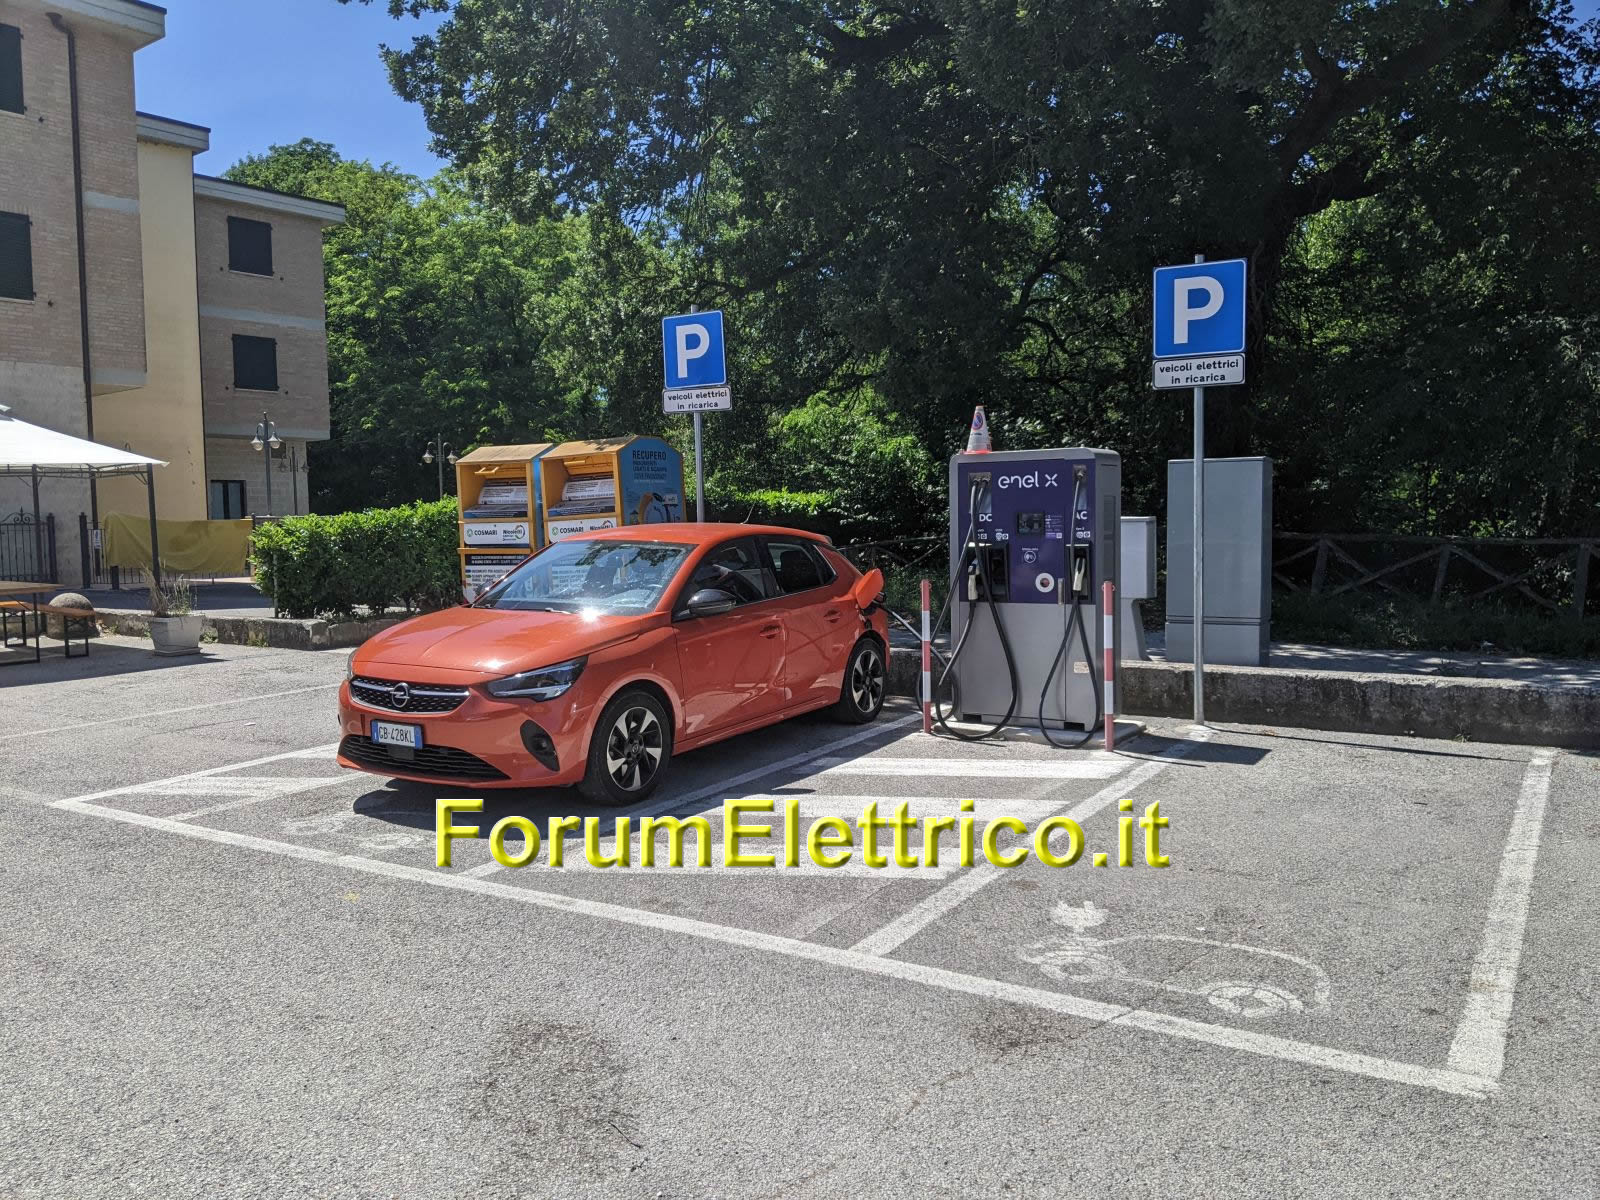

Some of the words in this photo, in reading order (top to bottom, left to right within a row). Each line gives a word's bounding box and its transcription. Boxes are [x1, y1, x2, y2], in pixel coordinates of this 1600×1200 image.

[1173, 275, 1225, 345] P
[675, 323, 710, 379] P
[1159, 362, 1192, 374] veicoli
[1196, 359, 1239, 371] elettrici
[1171, 376, 1181, 385] in
[1185, 373, 1226, 384] ricarica
[667, 392, 693, 401] veicoli
[695, 389, 728, 399] elettrici
[688, 400, 719, 410] ricarica
[632, 449, 667, 461] RECUPERO
[998, 471, 1040, 489] enel
[979, 513, 993, 522] DC
[559, 526, 584, 534] COSMARI
